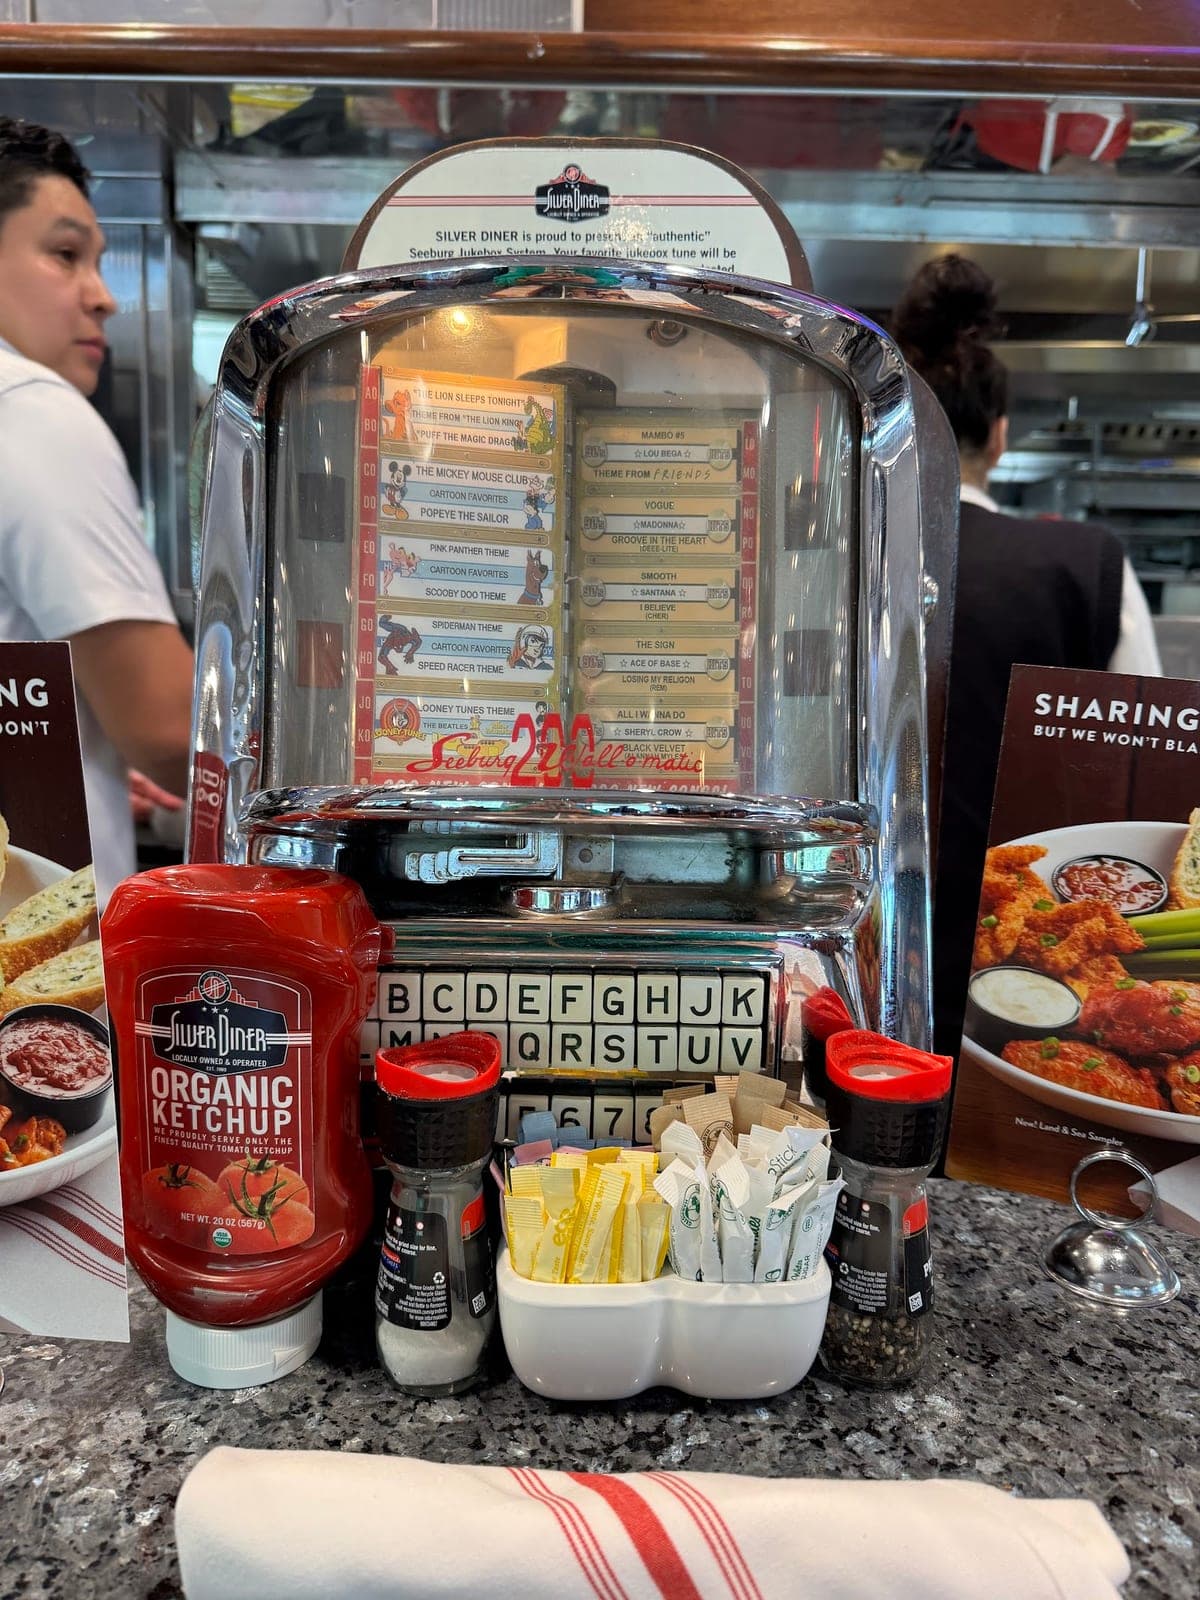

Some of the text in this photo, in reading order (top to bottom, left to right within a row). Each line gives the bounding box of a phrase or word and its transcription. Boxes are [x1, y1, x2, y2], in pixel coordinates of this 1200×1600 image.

[436, 231, 476, 241] SILVER
[481, 231, 518, 241] DINER
[523, 231, 531, 241] is
[536, 231, 567, 243] proud
[571, 232, 581, 241] to
[410, 248, 454, 258] Seeburg
[672, 249, 696, 258] tune
[700, 248, 719, 258] will
[723, 248, 737, 258] be
[435, 392, 453, 401] LION
[455, 394, 486, 404] SLEEPS
[439, 412, 460, 422] FROM
[482, 415, 499, 425] LION
[443, 432, 459, 442] THE
[460, 434, 486, 444] MAGIC
[641, 431, 685, 439] MAMBO #5
[643, 450, 682, 458] LOU BEGA
[416, 466, 528, 485] THE MICKEY MOUSE CLUB
[594, 470, 623, 478] THEME
[626, 470, 650, 478] FROM
[430, 489, 508, 504] CARTOON FAVORITES
[645, 501, 674, 510] VOGUE
[421, 508, 509, 523] POPEYE THE SAILOR
[640, 520, 679, 529] MADONNA
[612, 535, 707, 545] GROOVE IN THE HEART
[430, 544, 509, 557] PINK PANTHER THEME
[430, 566, 508, 579] CARTOON FAVORITES
[640, 572, 677, 580] SMOOTH
[425, 588, 506, 601] SCOOBY DOO THEME
[640, 589, 676, 597] SANTANA
[645, 604, 676, 612] BELIEVE
[432, 621, 503, 632] SPIDERMAN THEME
[431, 643, 511, 654] CARTOON FAVORITES
[636, 640, 675, 649] THE SIGN
[418, 661, 504, 673] SPEED RACER THEME
[630, 660, 680, 668] ACE OF BASE
[622, 676, 649, 684] LOSING
[650, 676, 662, 684] MY
[456, 705, 485, 714] TUNES
[486, 706, 515, 715] THEME
[617, 711, 634, 719] ALL
[673, 711, 685, 719] DO
[1034, 693, 1200, 731] SHARING
[658, 728, 682, 736] CROW
[1034, 725, 1200, 754] BUT WE WON'T BLA
[406, 732, 517, 776] Seeburg
[654, 744, 686, 752] VELVET
[388, 983, 756, 1017] B C D E F G H J K
[164, 1011, 266, 1056] SILVER DINER
[518, 1032, 540, 1061] Q
[560, 1033, 584, 1062] R
[603, 1034, 625, 1063] S
[646, 1035, 669, 1064] T
[687, 1036, 710, 1065] U
[732, 1037, 753, 1066] V
[172, 1054, 198, 1063] LOCALLY
[200, 1056, 223, 1065] OWNED
[233, 1059, 266, 1067] OPERATED
[151, 1067, 293, 1108] ORGANIC
[152, 1099, 292, 1135] KETCHUP
[604, 1107, 624, 1136] 7
[170, 1129, 206, 1140] PROUDLY
[212, 1135, 240, 1144] SERVE
[245, 1137, 268, 1145] ONLY
[1015, 1117, 1124, 1147] New! Land & Sea Sampler
[154, 1136, 293, 1155] FINEST QUALITY TOMATO KETCHUP
[181, 1212, 266, 1230] NET WT. 20 OZ (567g)
